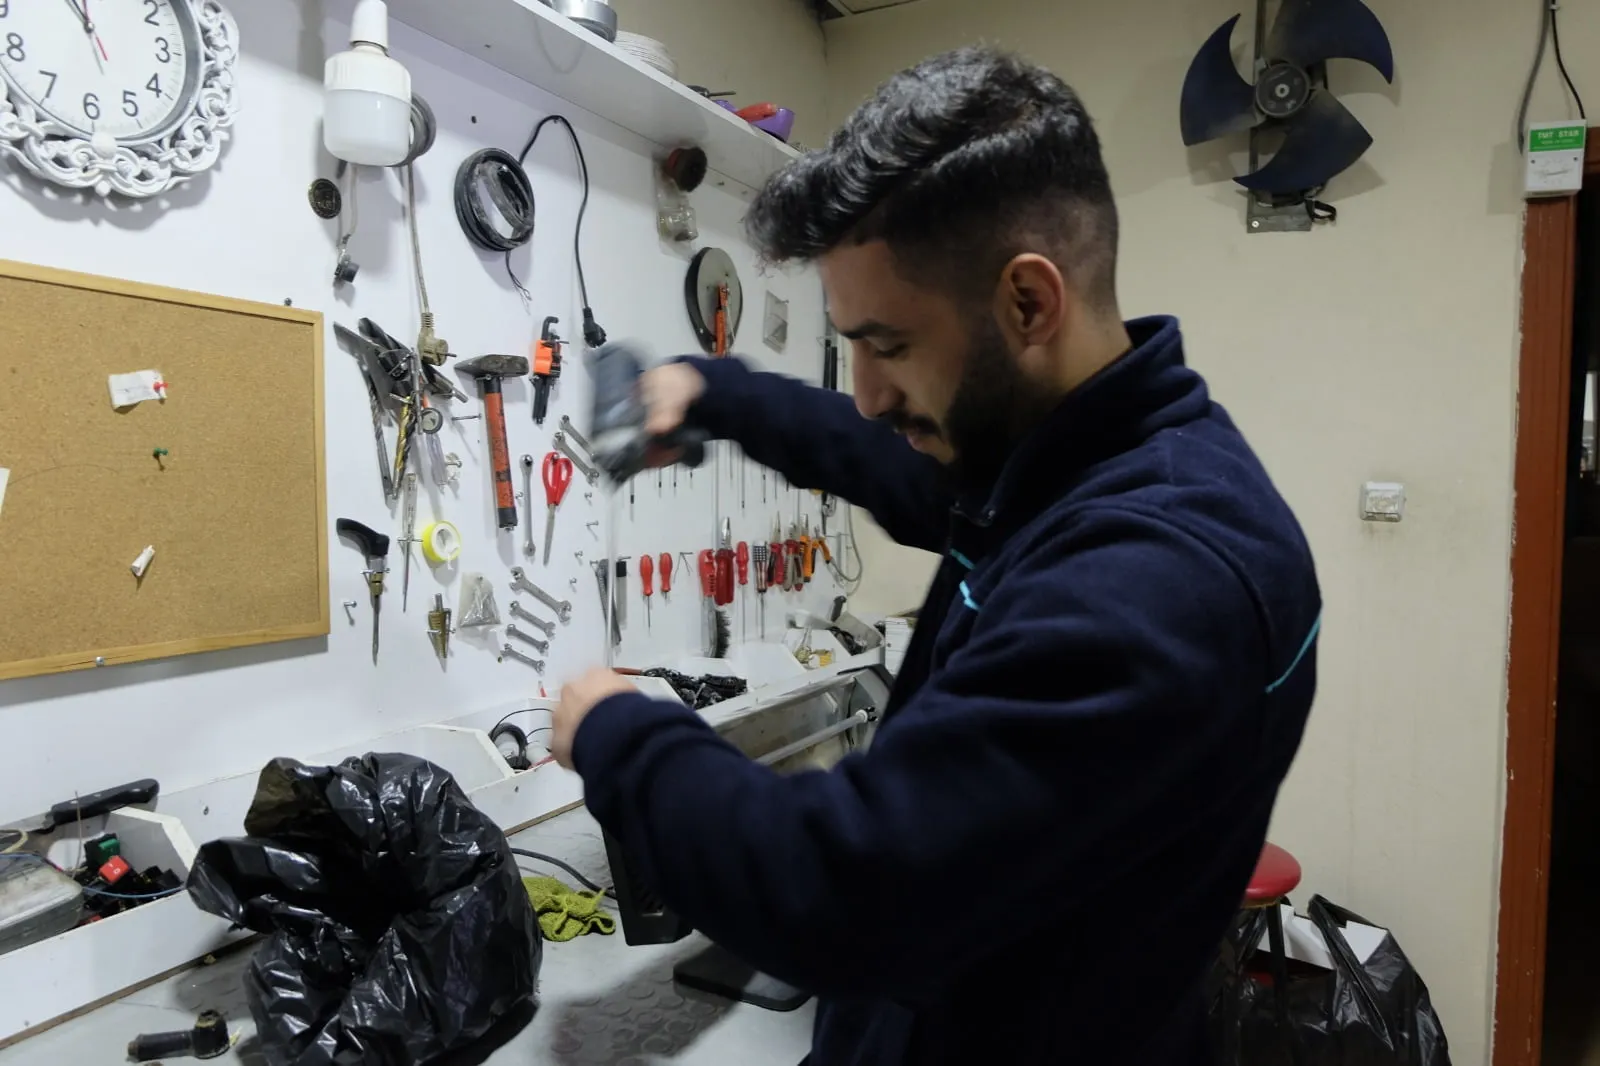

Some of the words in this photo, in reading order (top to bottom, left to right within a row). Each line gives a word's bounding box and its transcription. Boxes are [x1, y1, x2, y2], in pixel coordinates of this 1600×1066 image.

[144, 0, 160, 26] 2
[6, 32, 25, 61] 8
[155, 37, 170, 62] 3
[39, 70, 57, 98] 7
[145, 73, 163, 98] 4
[83, 93, 100, 120] 6
[122, 90, 139, 117] 5
